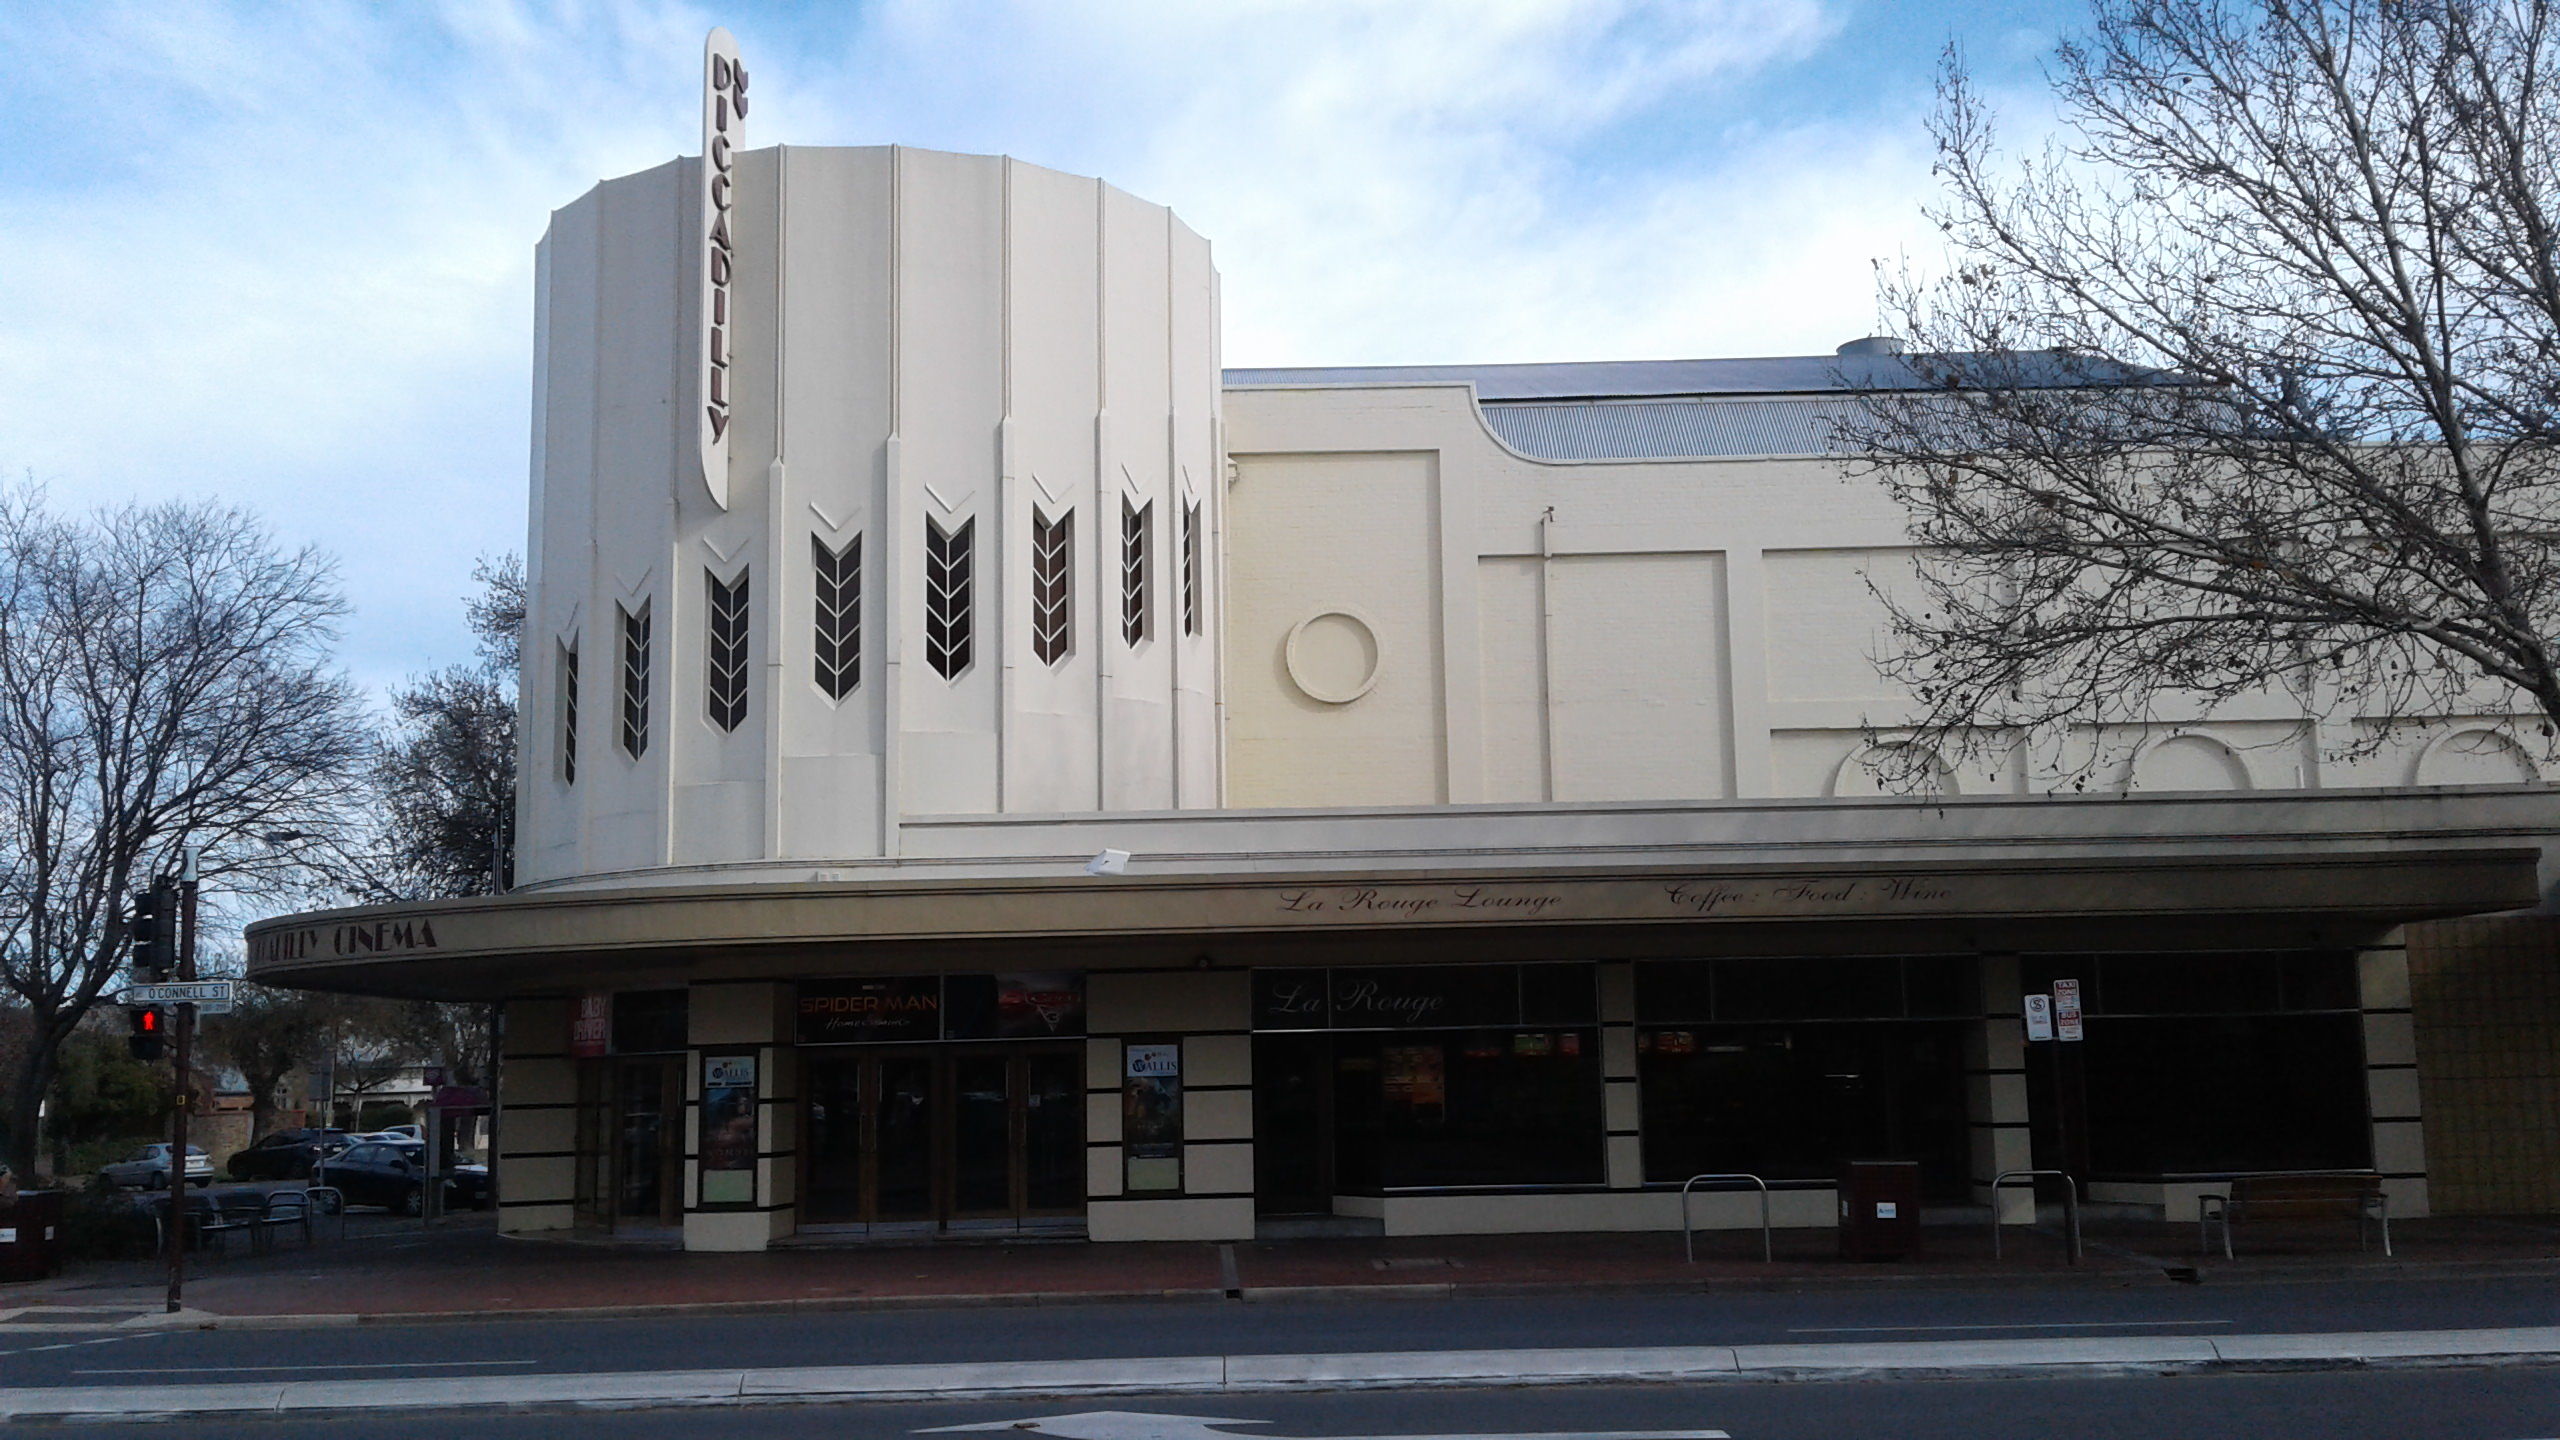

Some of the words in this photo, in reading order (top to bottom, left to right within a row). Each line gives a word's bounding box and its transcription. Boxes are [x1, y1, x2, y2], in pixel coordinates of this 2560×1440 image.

[1279, 889, 1323, 911] La
[1338, 888, 1440, 918] Rouge
[1455, 887, 1563, 915] Lounge
[1664, 882, 1744, 911] Coffee
[1773, 880, 1857, 902] Food
[1880, 878, 1952, 901] Wine
[334, 919, 437, 955] CINEMA
[148, 986, 206, 999] O'CONNELL
[212, 985, 225, 998] ST
[799, 996, 879, 1013] SPIDER
[1268, 982, 1321, 1013] La
[1335, 978, 1445, 1024] Rouge
[1132, 1058, 1177, 1073] WALLIS
